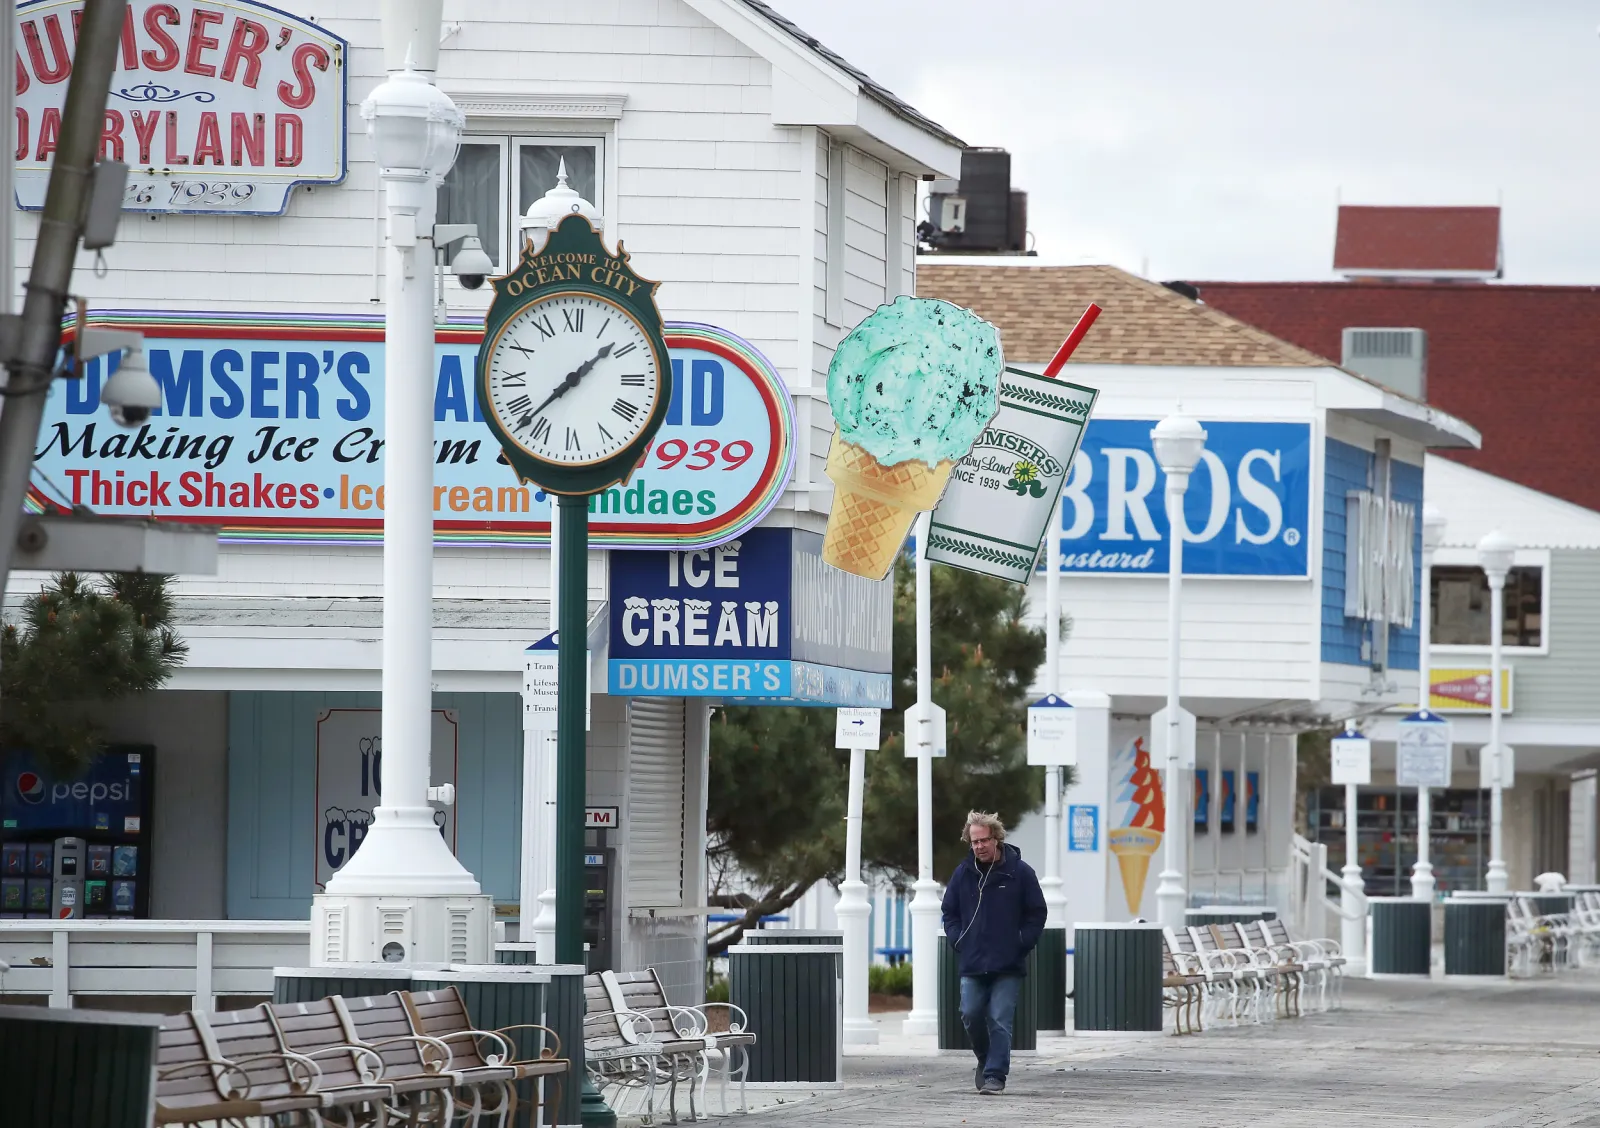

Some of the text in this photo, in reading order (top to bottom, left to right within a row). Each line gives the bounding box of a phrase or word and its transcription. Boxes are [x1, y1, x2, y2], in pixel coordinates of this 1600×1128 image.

[16, 107, 303, 167] ARYLAND
[168, 181, 256, 205] 1939
[527, 252, 621, 271] WELCOME TO
[507, 264, 641, 297] OCEAN CITY
[531, 313, 556, 343] XI
[562, 308, 584, 333] XII
[509, 339, 535, 360] X
[613, 342, 637, 359] II
[65, 348, 371, 421] DMSER'S
[501, 371, 526, 388] IX
[621, 374, 645, 387] III
[530, 416, 552, 445] VII
[566, 426, 581, 451] VI
[597, 421, 613, 443] V
[33, 422, 235, 469] Making
[248, 426, 320, 463] Ice
[332, 427, 481, 464] Crm
[960, 455, 1015, 476] airy Land
[65, 469, 172, 507] Thick
[179, 471, 319, 509] Shakes
[433, 486, 530, 512] ream
[588, 479, 717, 515] ndaes
[979, 476, 1000, 490] 1939
[1057, 447, 1284, 546] BROS
[668, 540, 742, 588] ICE
[1060, 547, 1155, 568] ustard
[621, 596, 779, 647] CREAM
[533, 662, 554, 670] Tram
[619, 662, 780, 691] DUMSER'S
[533, 704, 557, 712] Transi
[52, 778, 131, 806] pepsi
